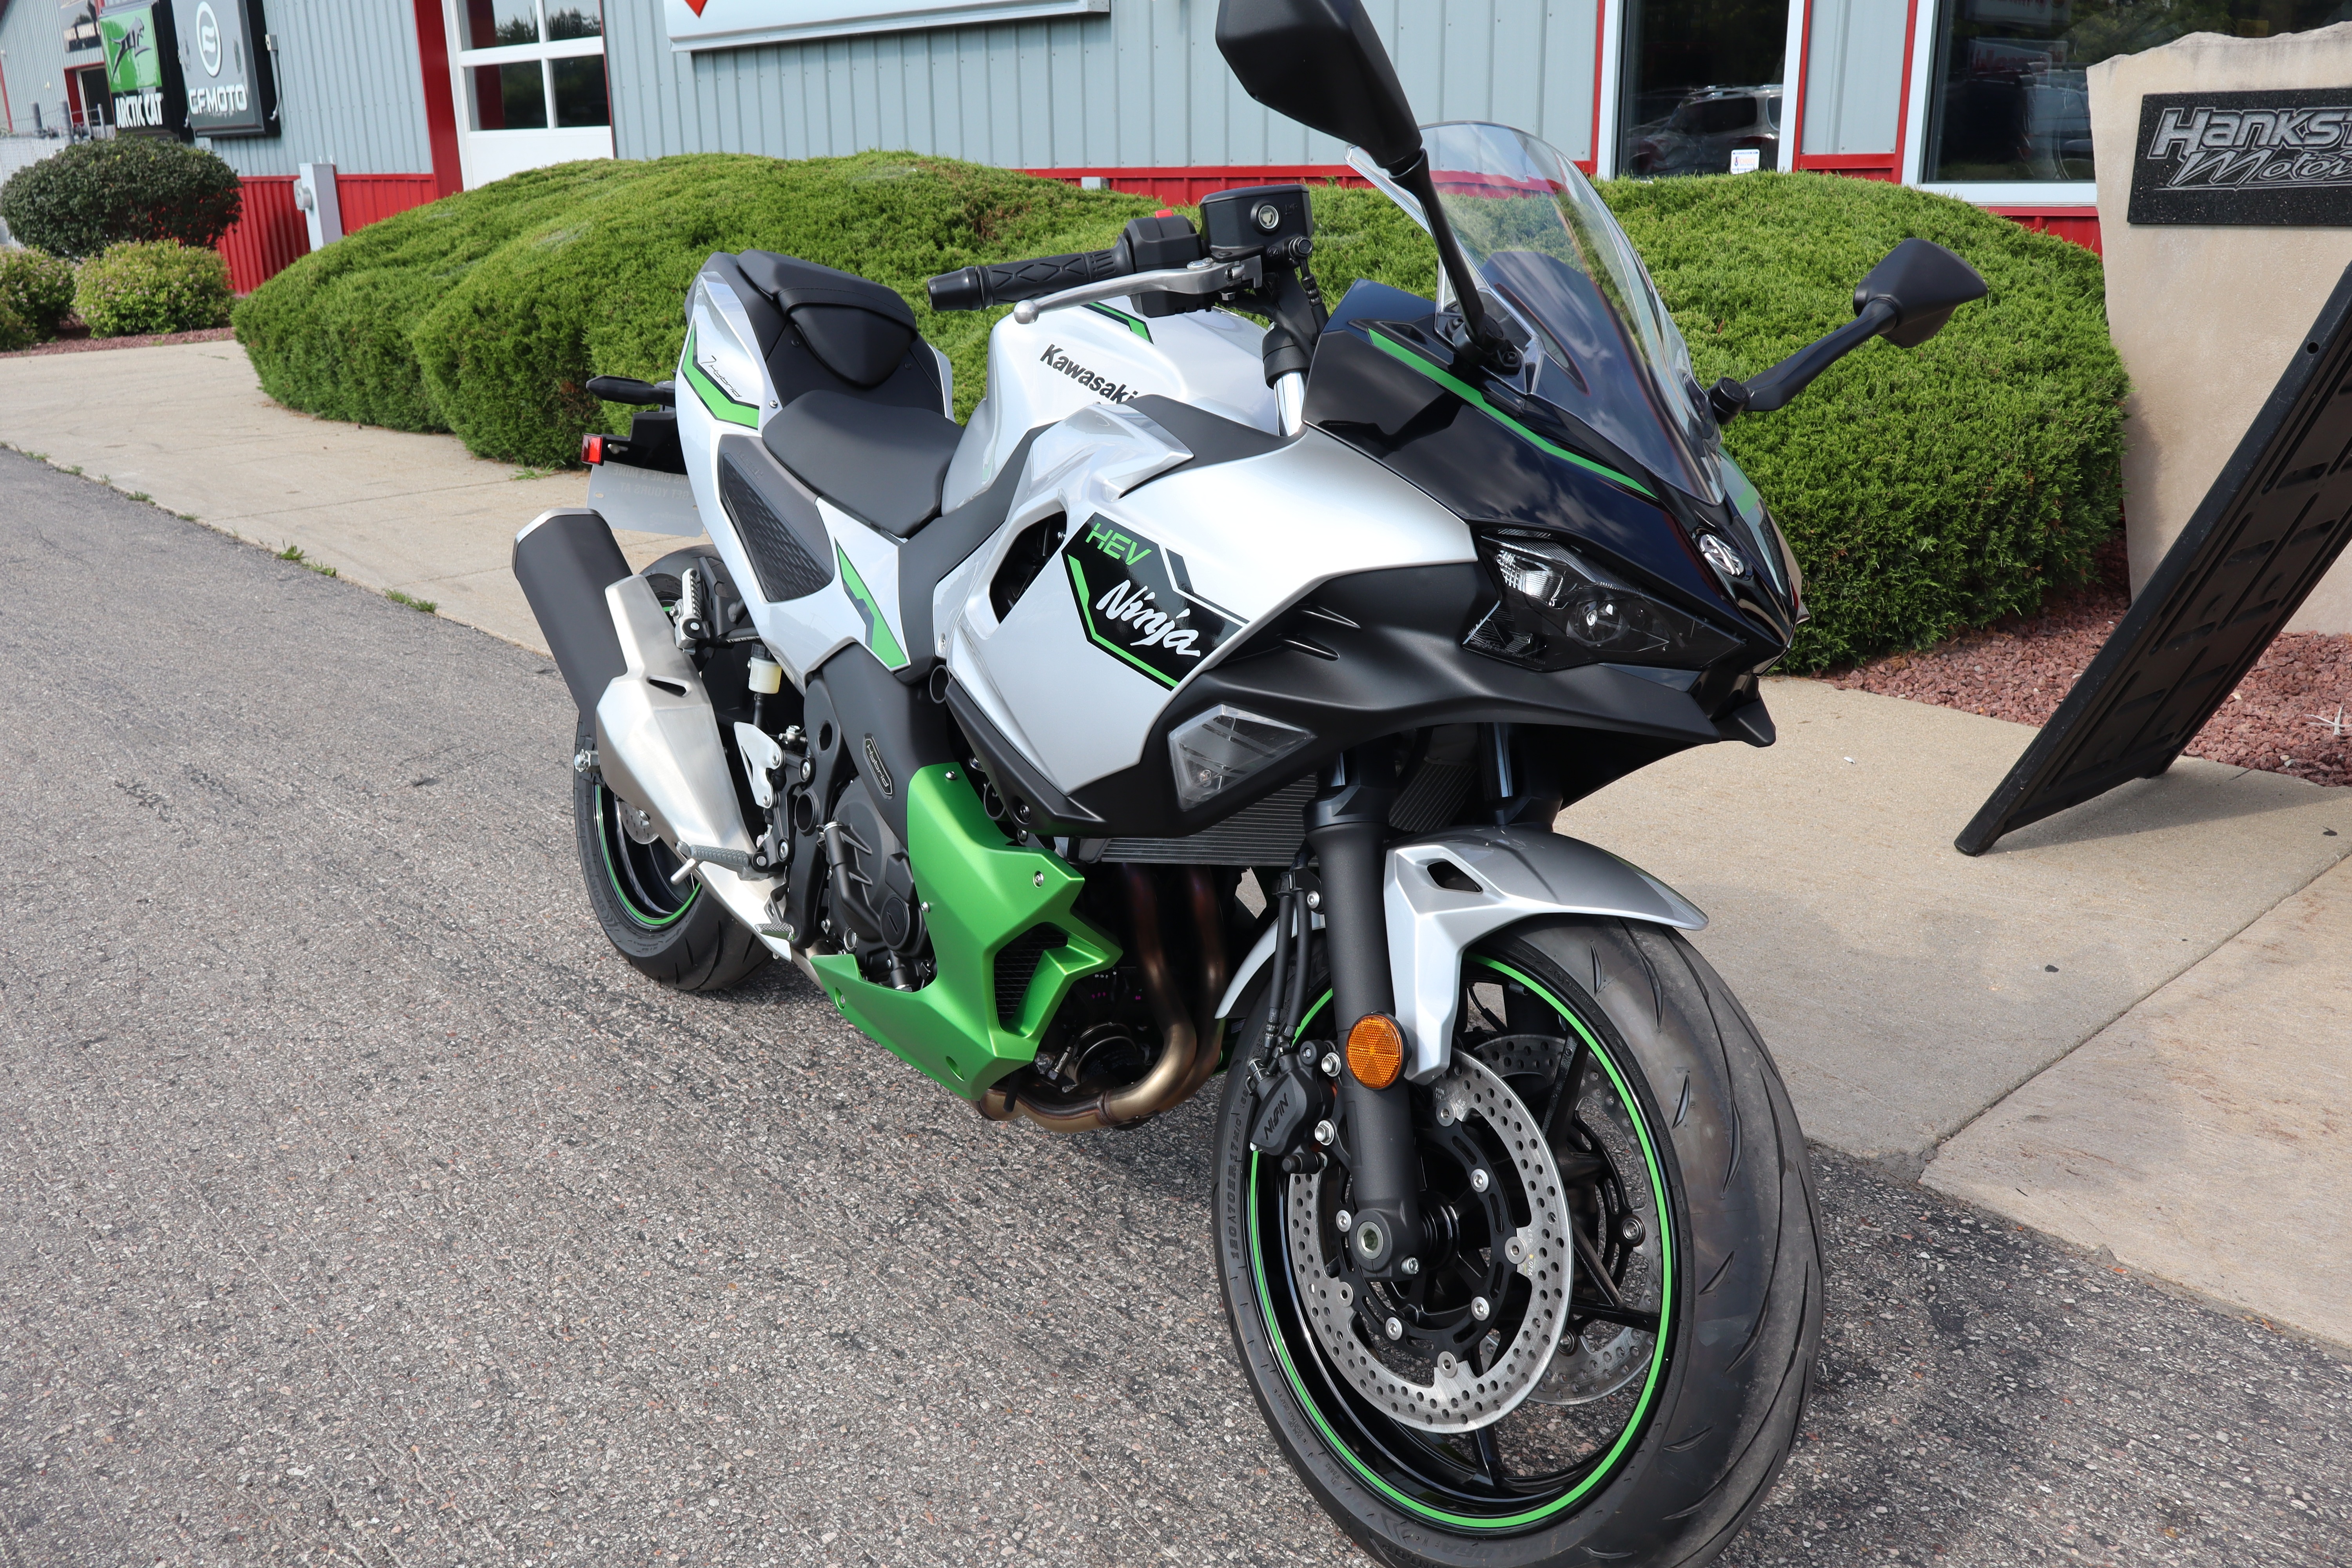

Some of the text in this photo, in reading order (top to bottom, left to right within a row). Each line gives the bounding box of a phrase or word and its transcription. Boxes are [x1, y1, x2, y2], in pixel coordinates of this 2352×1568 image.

[115, 92, 163, 129] ARCTIC CAT
[189, 84, 248, 114] CFMOTO
[2167, 147, 2352, 187] Motor
[708, 365, 742, 397] Hybrid
[1085, 523, 1152, 566] HEV
[1096, 579, 1201, 657] Ninja
[867, 744, 889, 788] Hybrid
[1435, 1087, 1445, 1096] MIN.
[1264, 1093, 1289, 1141] NISSIN
[1288, 1411, 1305, 1436] SPORTMAX
[1288, 1421, 1301, 1439] DUNLOP
